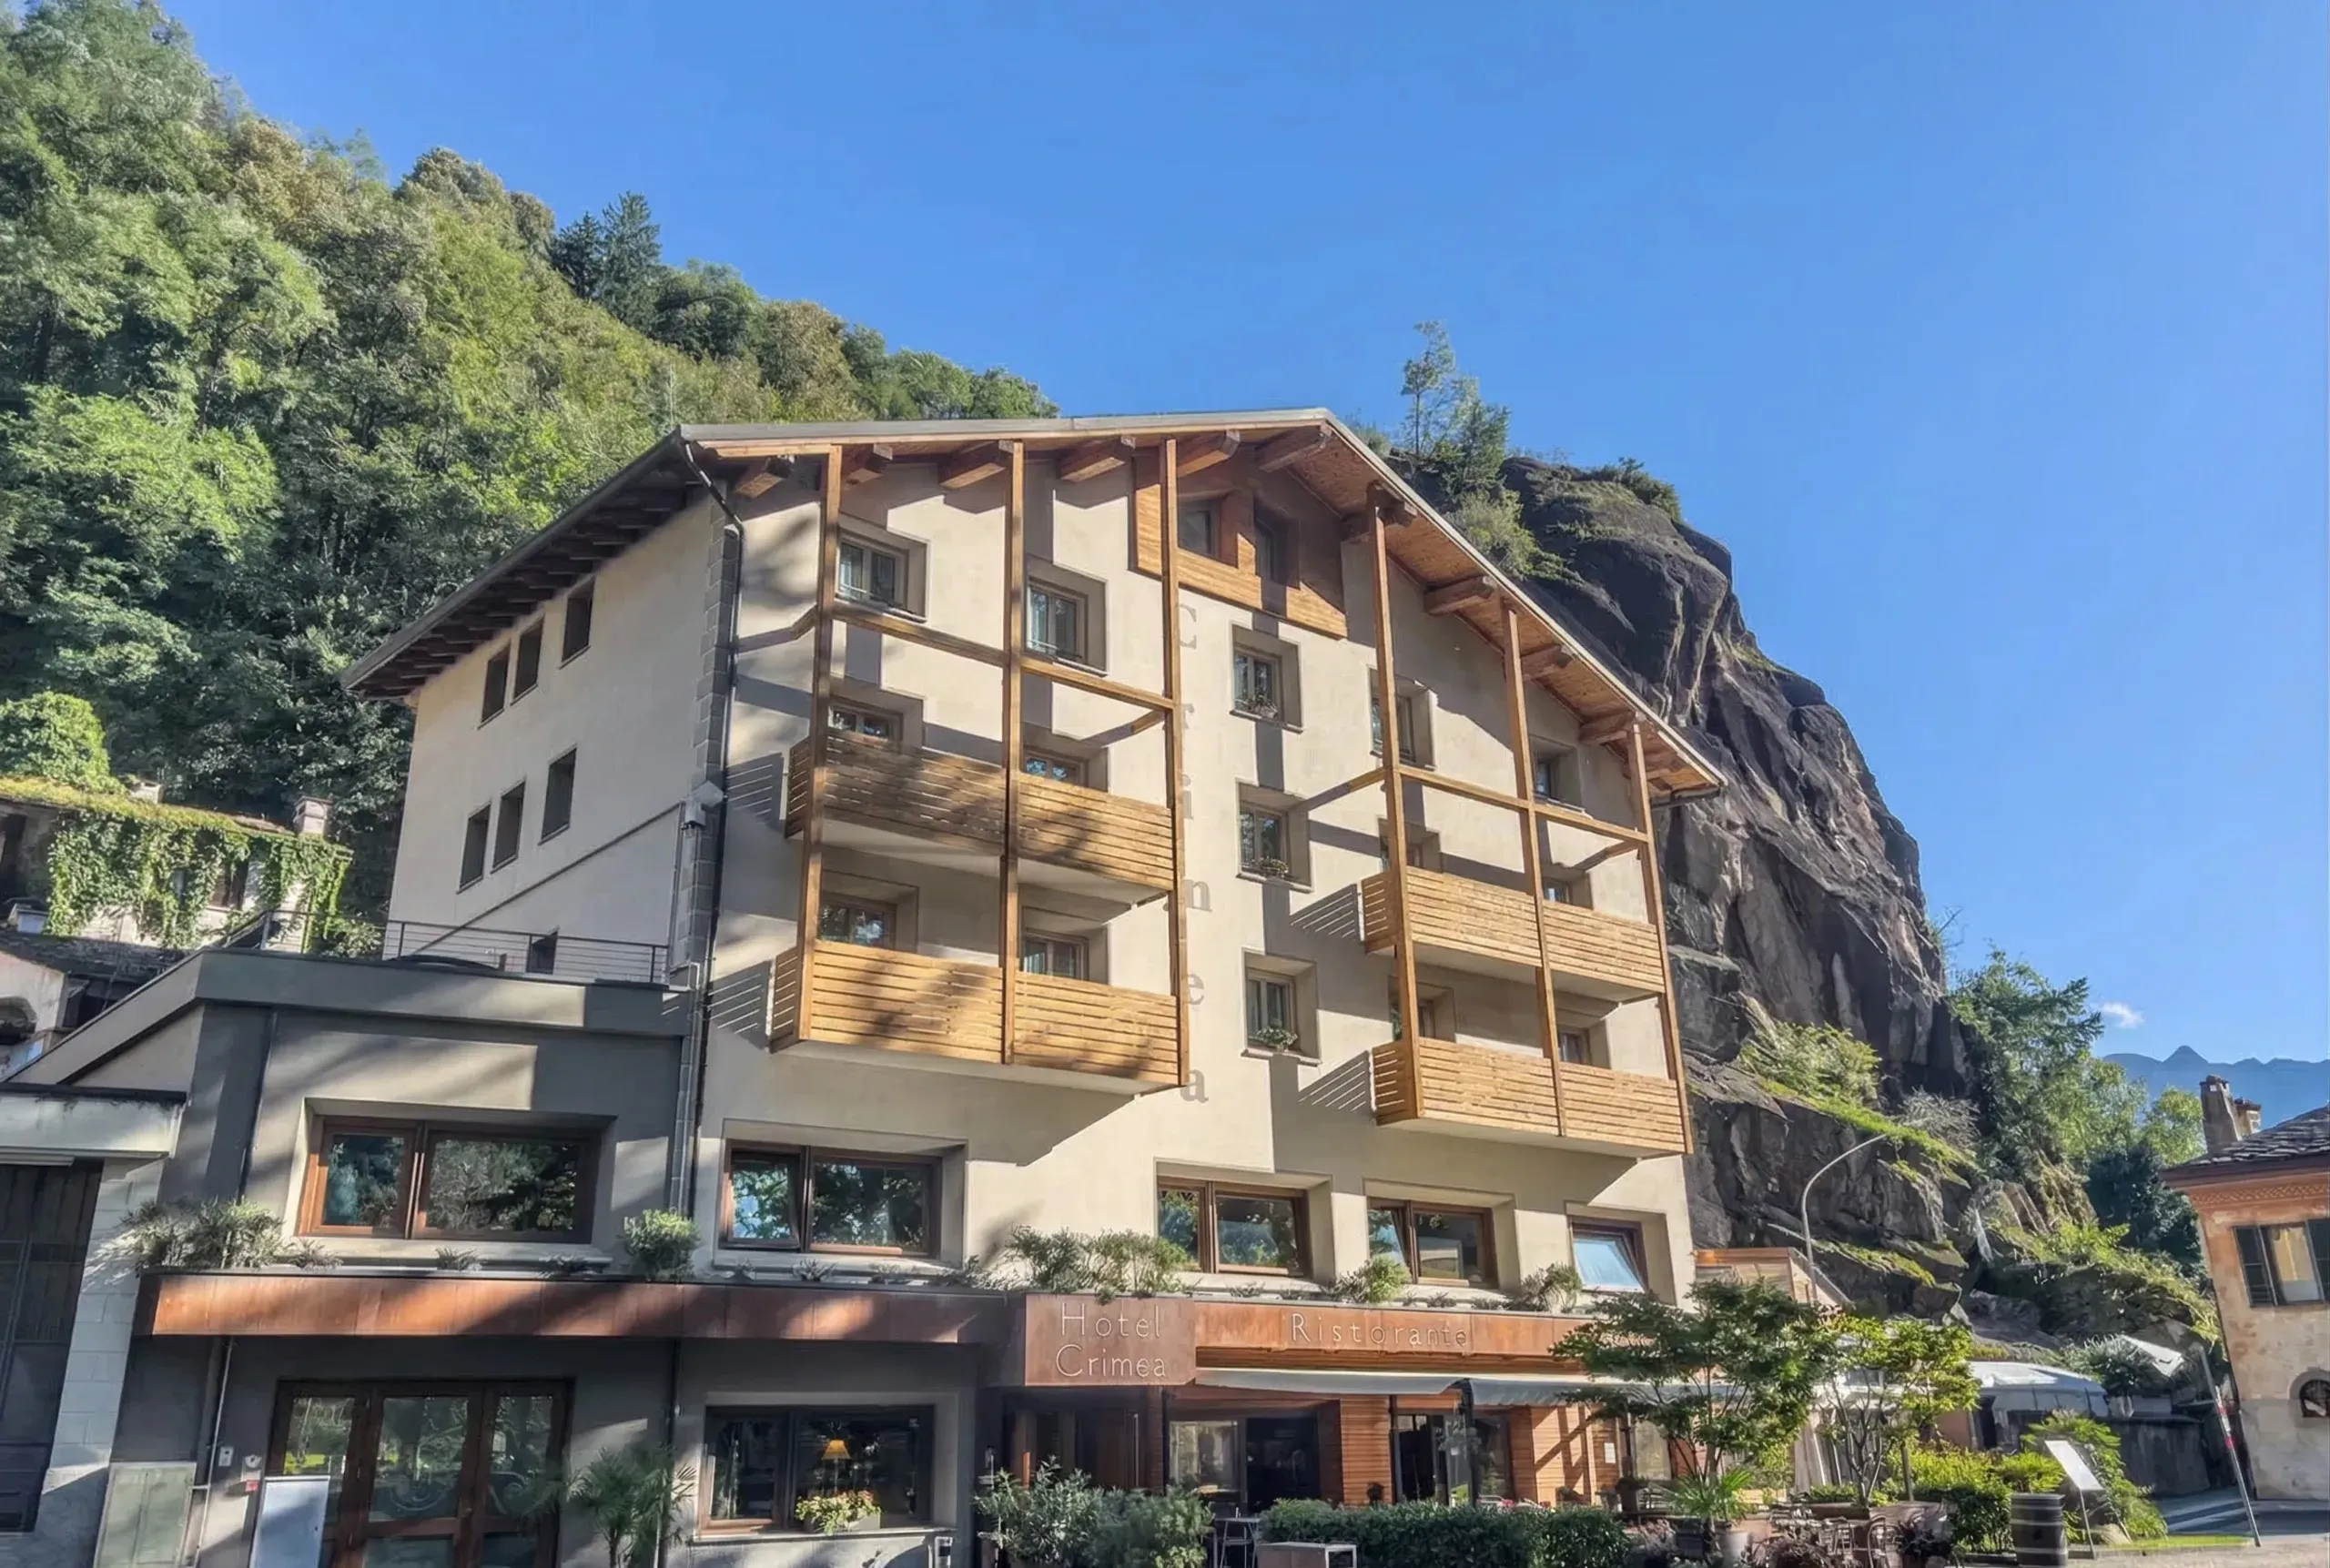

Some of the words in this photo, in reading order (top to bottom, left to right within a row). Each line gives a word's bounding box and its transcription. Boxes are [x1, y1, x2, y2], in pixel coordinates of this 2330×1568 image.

[1061, 1302, 1160, 1338] Hotel
[1292, 1313, 1467, 1347] Ristorante
[1056, 1343, 1166, 1377] Crimea
